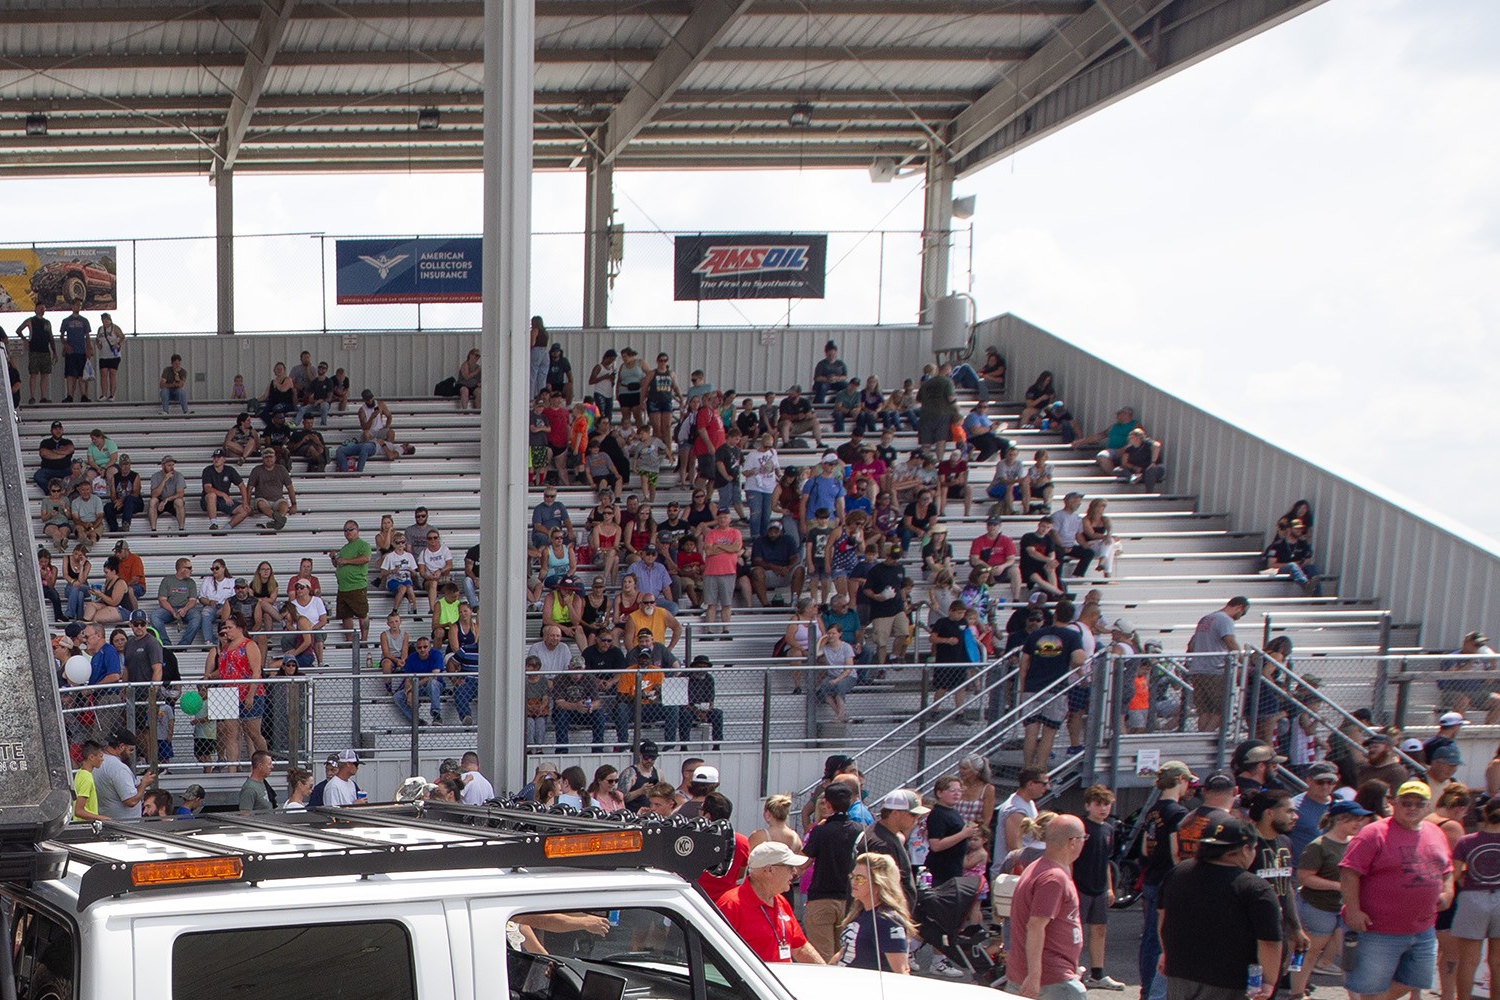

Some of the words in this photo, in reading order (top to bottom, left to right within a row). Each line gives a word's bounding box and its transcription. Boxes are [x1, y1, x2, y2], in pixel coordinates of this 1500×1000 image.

[420, 251, 464, 260] AMERICAN
[420, 261, 473, 270] COLLECTORS
[696, 247, 807, 276] AMSOIL
[420, 270, 468, 280] INSURANCE
[700, 280, 717, 288] The
[718, 280, 740, 288] First
[753, 279, 804, 289] Synthetics
[678, 840, 690, 852] KC
